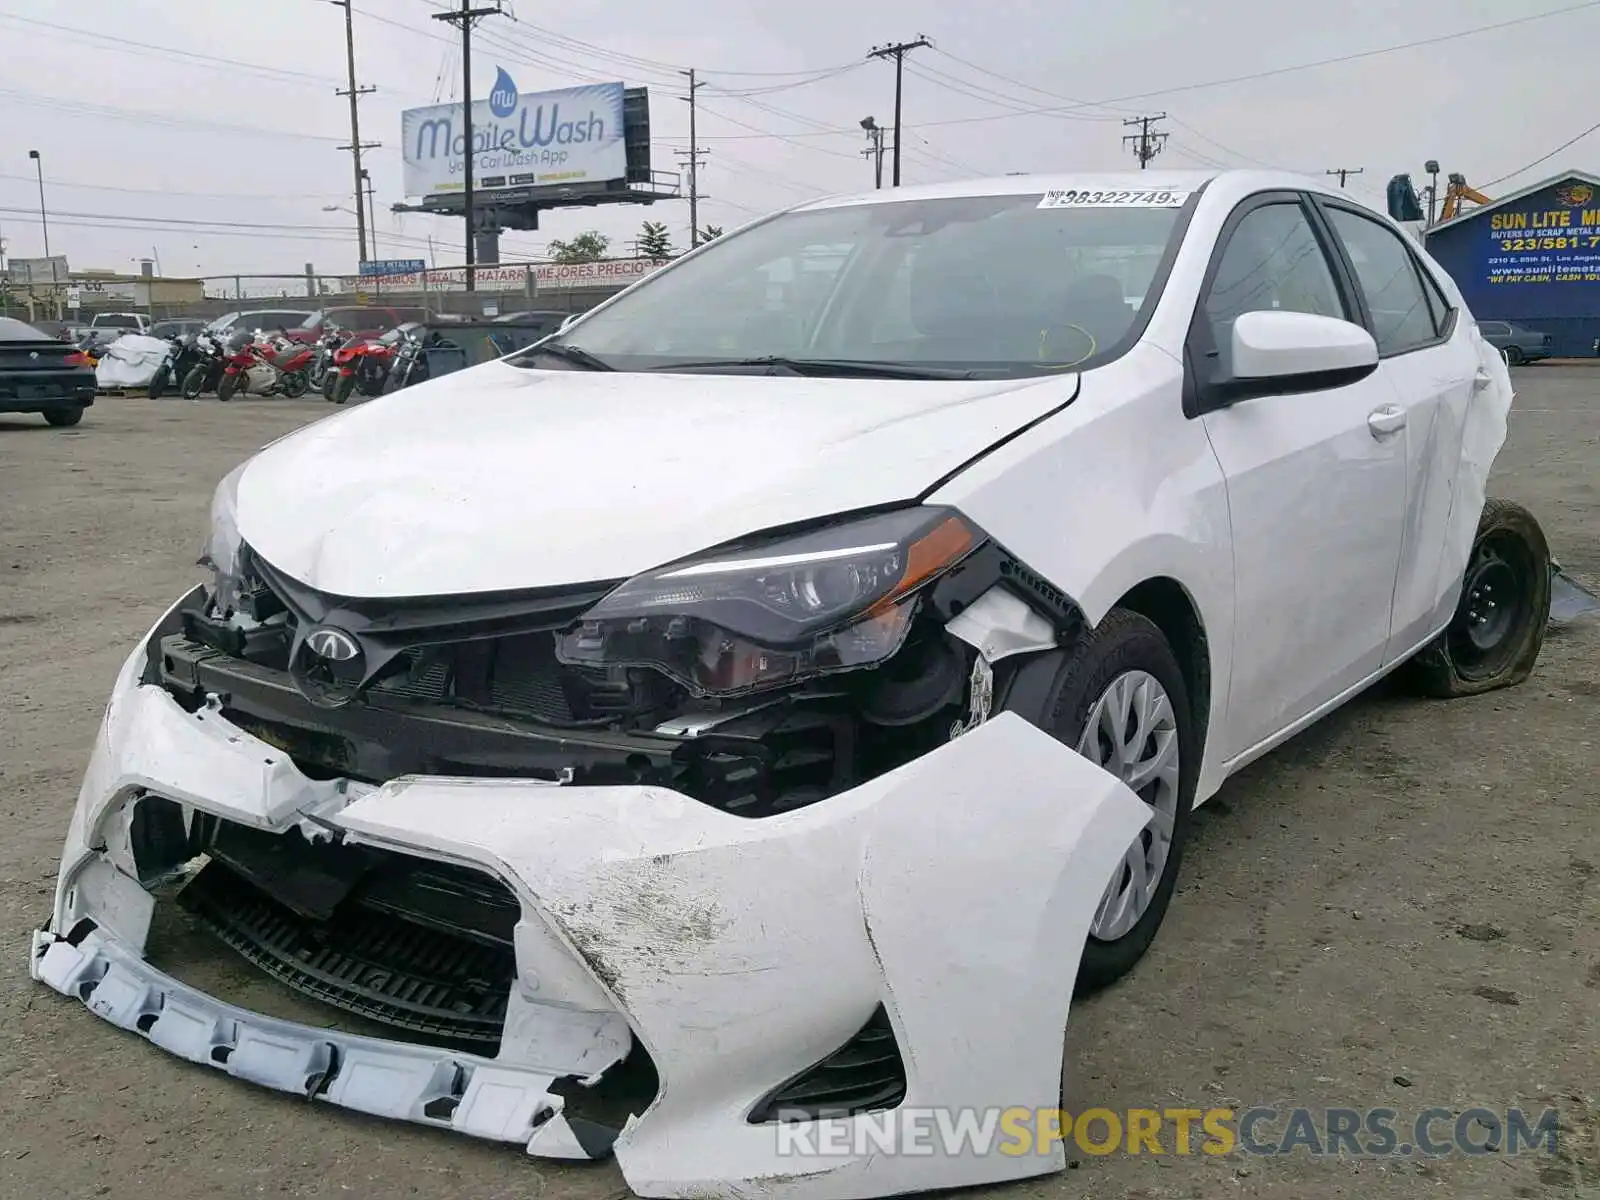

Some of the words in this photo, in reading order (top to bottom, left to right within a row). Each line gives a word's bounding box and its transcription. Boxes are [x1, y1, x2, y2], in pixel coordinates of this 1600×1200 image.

[540, 149, 568, 166] App
[1491, 213, 1528, 230] SUN
[1532, 210, 1571, 228] LITE
[1490, 230, 1522, 240] BUYERS
[1536, 228, 1564, 237] SCRAP
[1566, 226, 1593, 236] METAL
[537, 265, 597, 280] MEJORES
